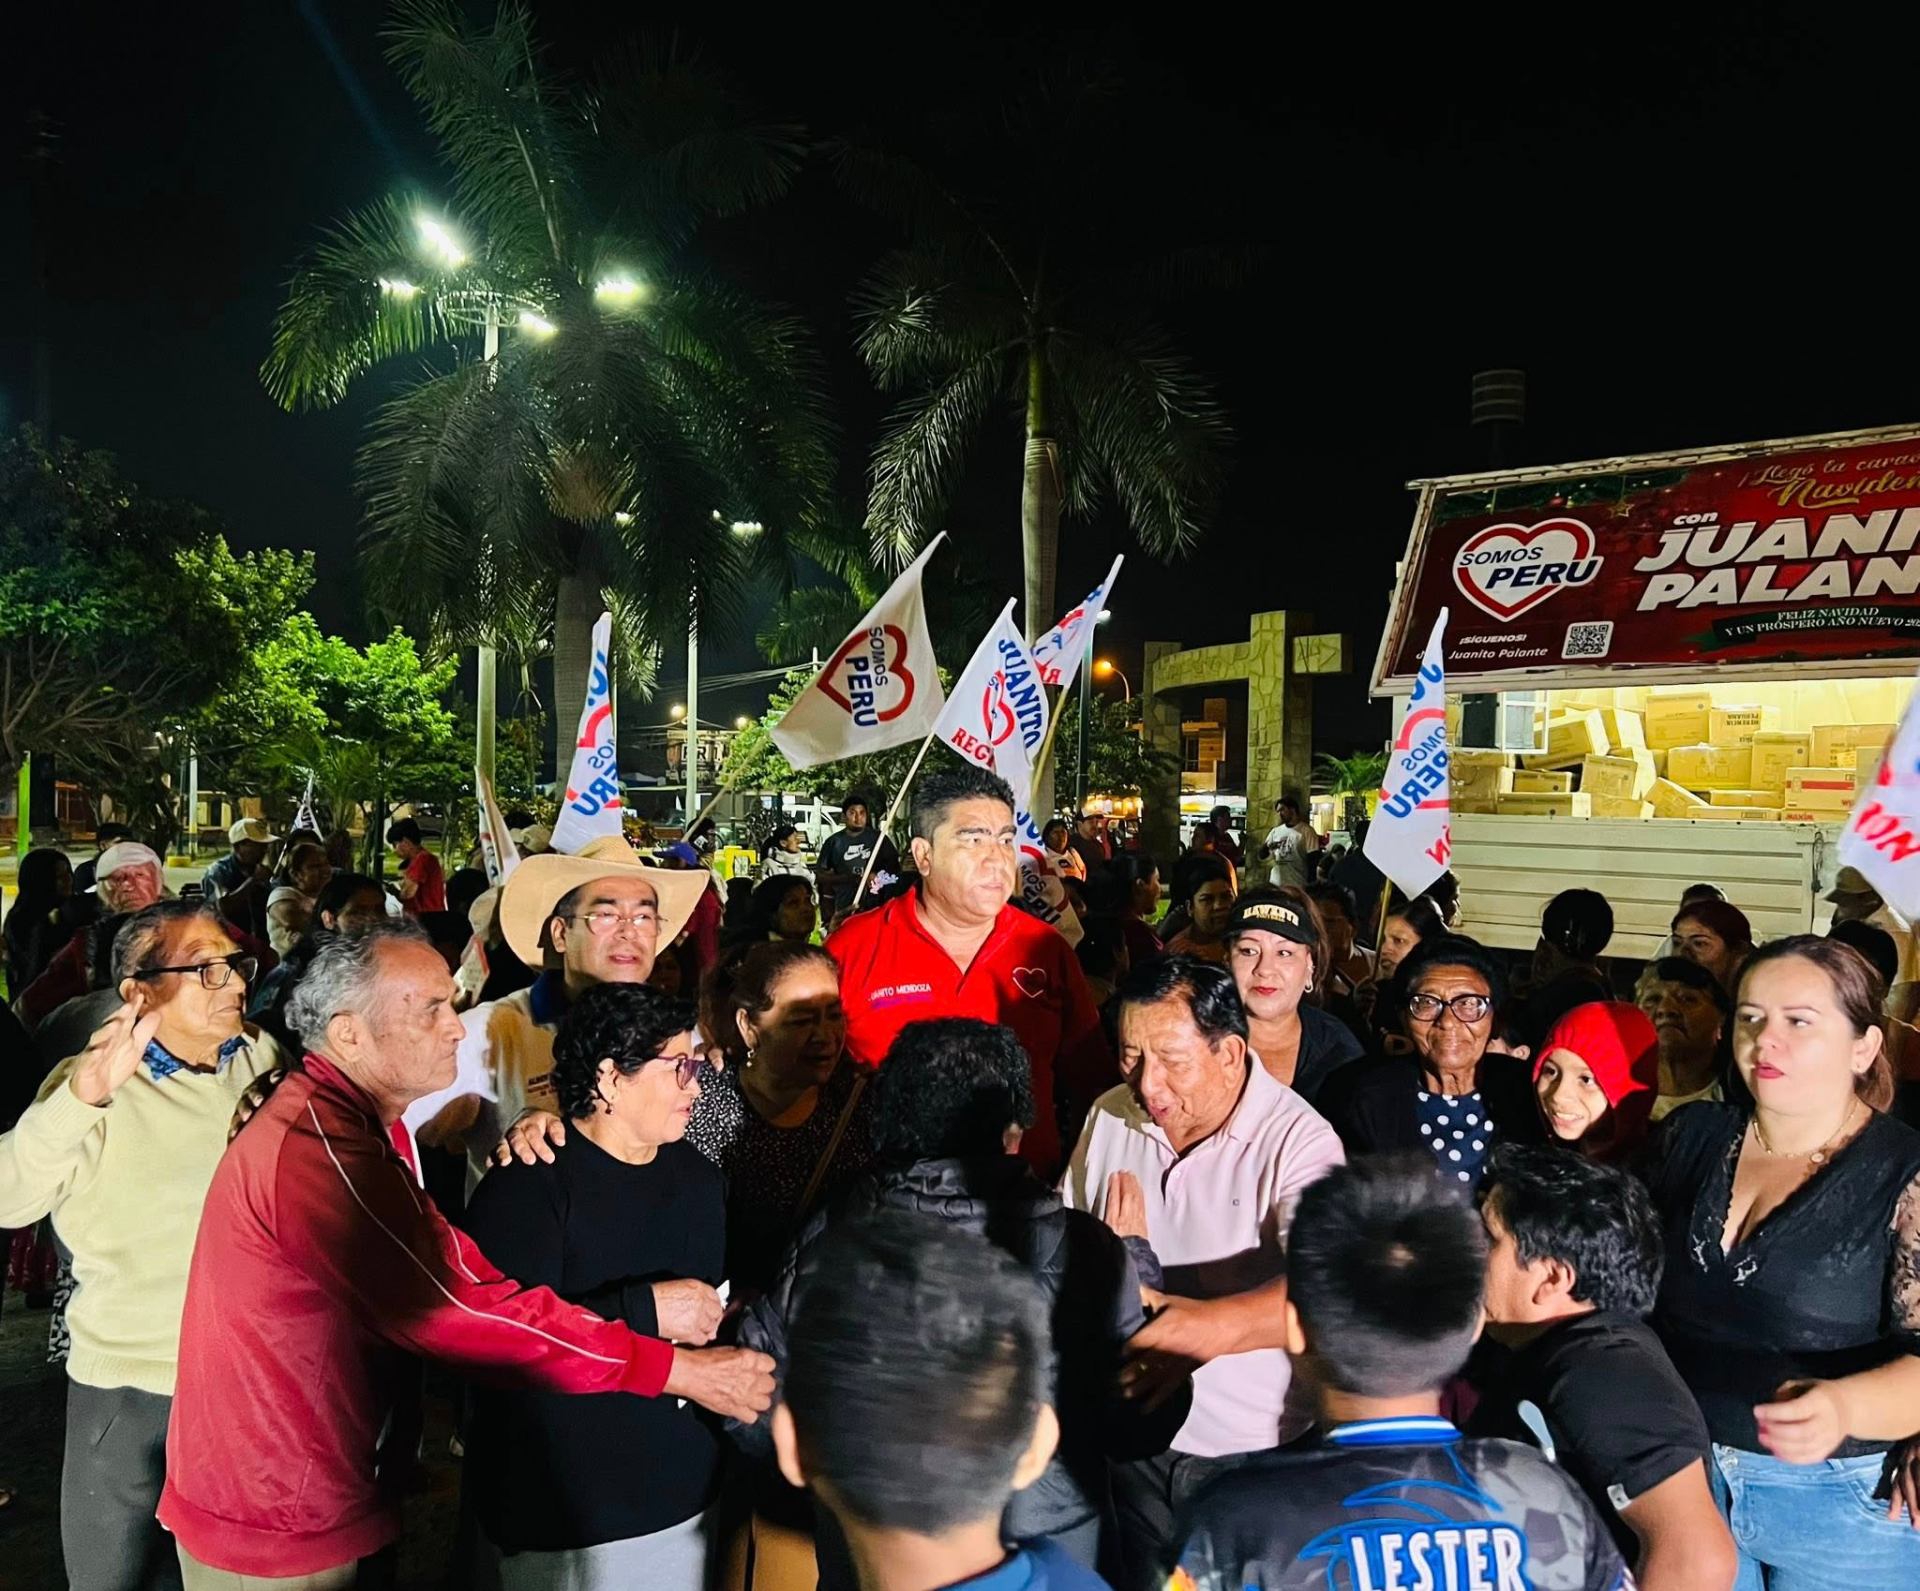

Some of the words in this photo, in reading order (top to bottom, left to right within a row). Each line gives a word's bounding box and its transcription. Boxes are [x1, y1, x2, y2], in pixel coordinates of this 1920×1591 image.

[1824, 459, 1847, 473] la
[1673, 511, 1718, 525] con
[1459, 546, 1544, 566] SOMOS
[1485, 560, 1599, 589] PERU
[1636, 555, 1920, 611] PALAN
[1725, 627, 1734, 637] Y
[1737, 623, 1755, 635] UN
[1757, 616, 1825, 633] PRÓSPERO
[1827, 614, 1856, 626] AÑO
[1858, 616, 1903, 626] NUEVO
[1778, 609, 1816, 621] FELIZ
[1818, 607, 1880, 618] NAVIDAD
[868, 626, 889, 686] SOMOS
[1449, 647, 1496, 660] Juanito
[1498, 647, 1548, 659] Palante
[845, 656, 878, 727] PERU
[998, 639, 1043, 749] JUANITO
[1351, 1529, 1528, 1591] LESTER
